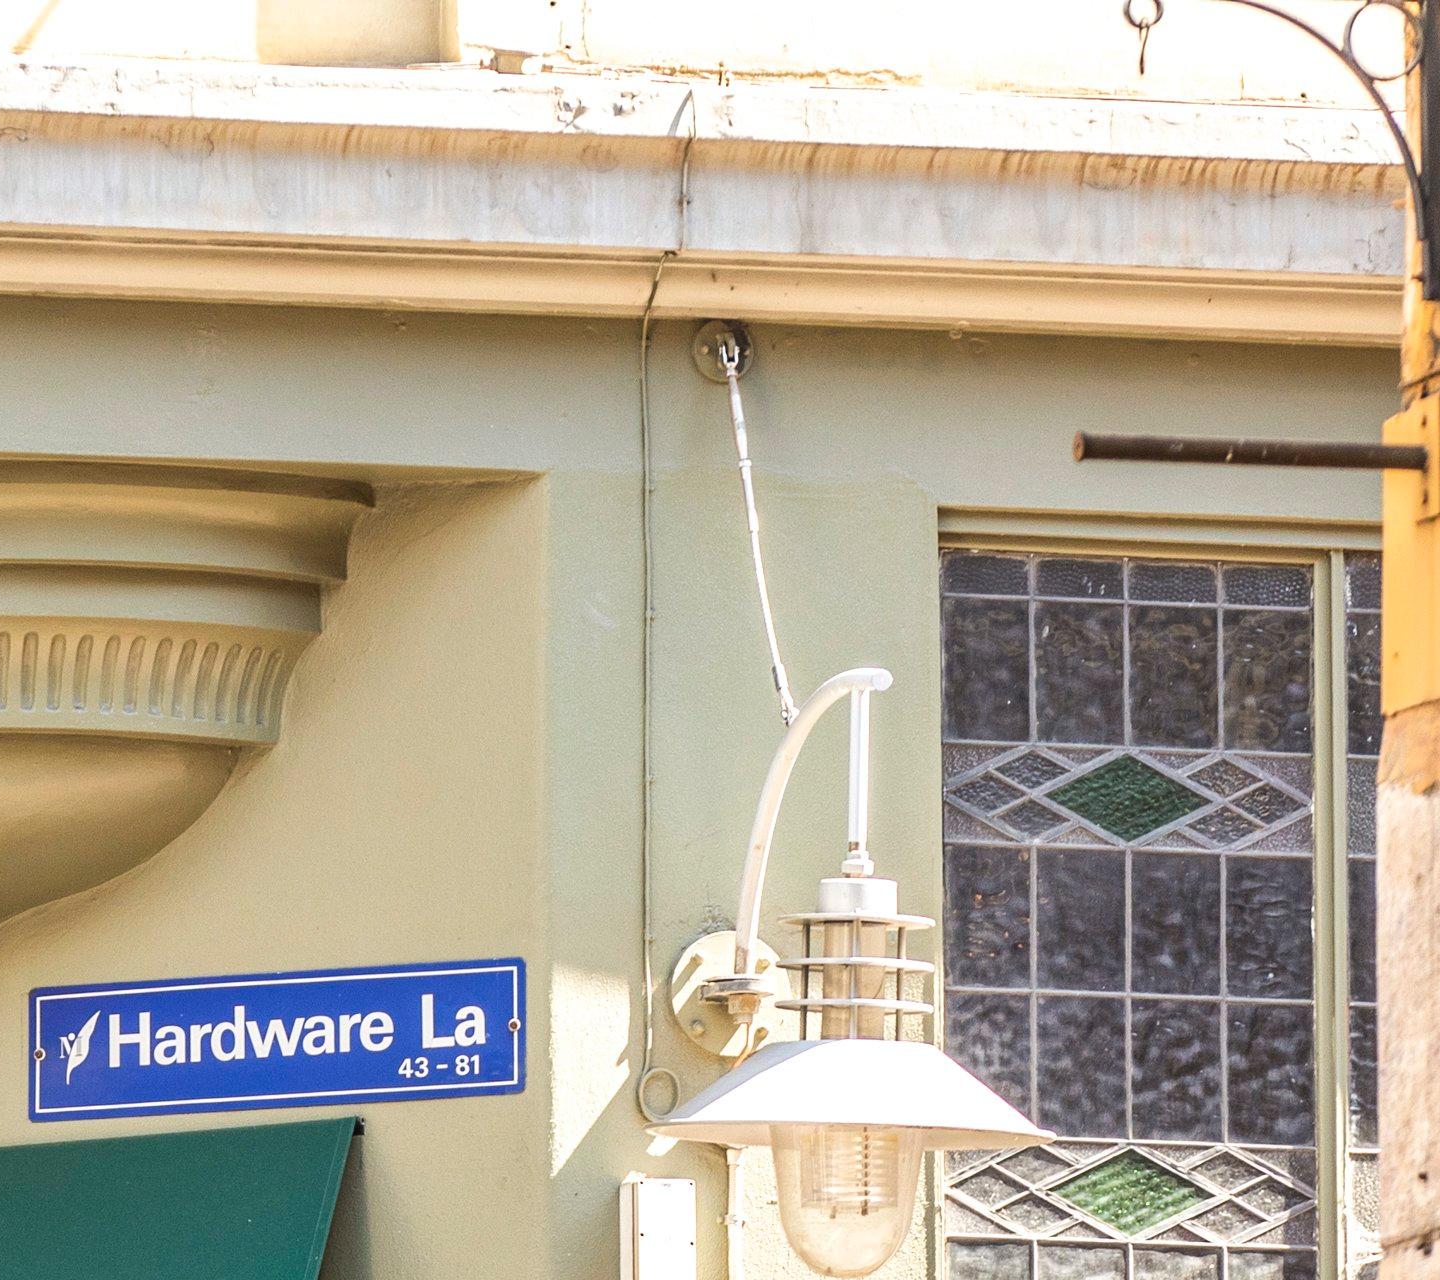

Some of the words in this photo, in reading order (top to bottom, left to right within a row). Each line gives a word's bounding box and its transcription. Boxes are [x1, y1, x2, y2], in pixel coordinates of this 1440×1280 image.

[107, 1003, 396, 1069] Hardware
[420, 992, 488, 1051] La
[396, 1056, 430, 1080] 43
[455, 1054, 482, 1077] 81
